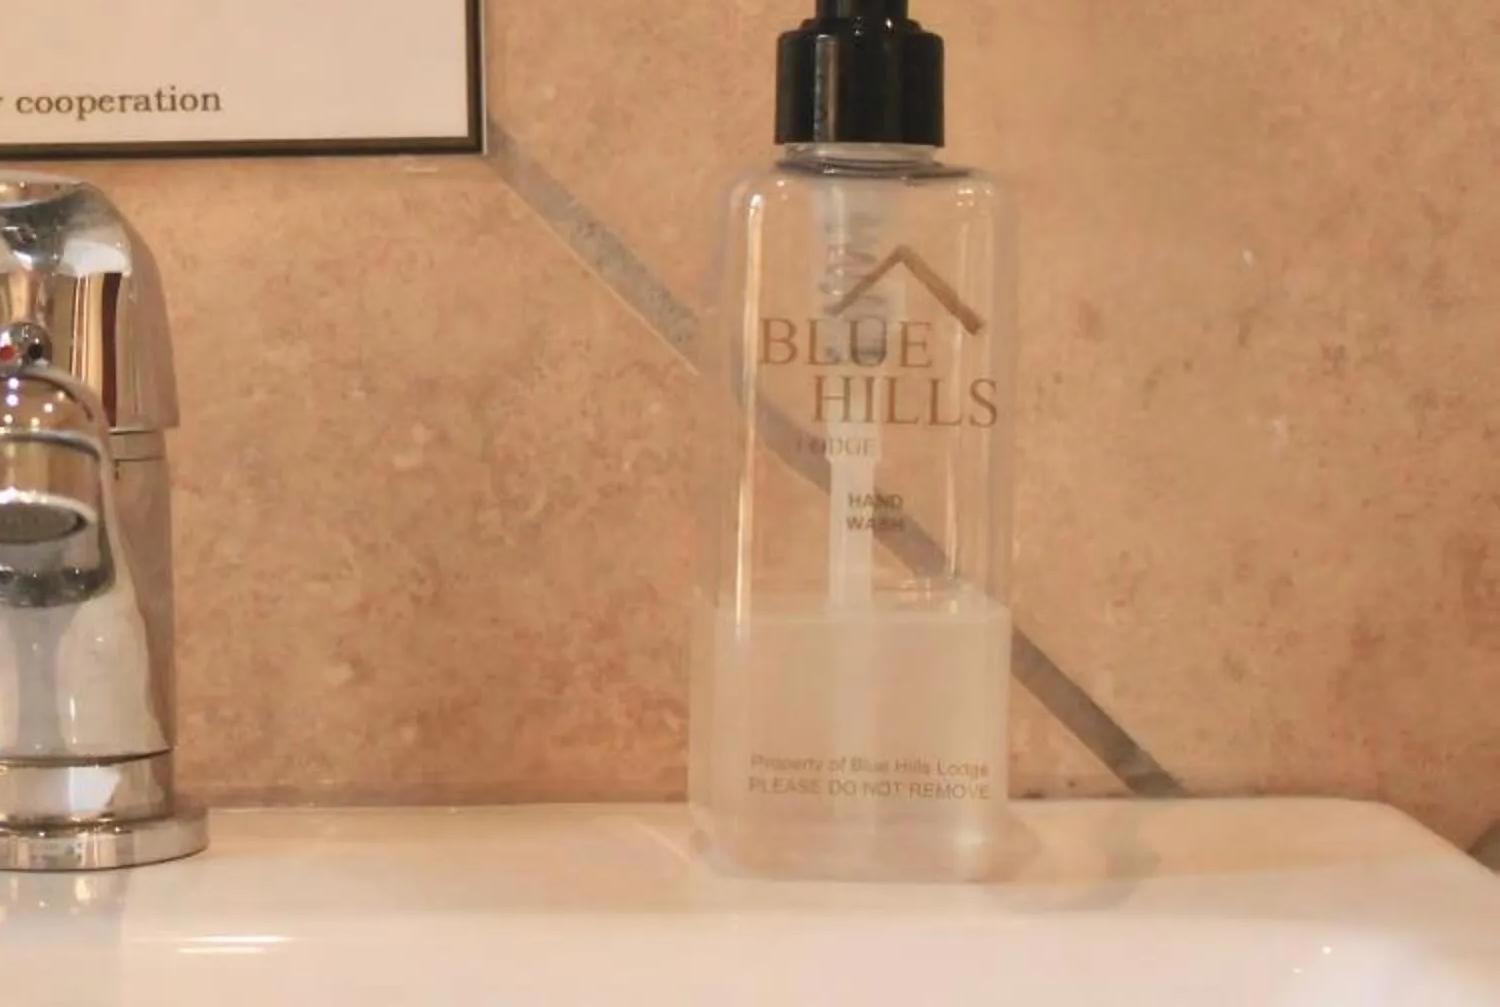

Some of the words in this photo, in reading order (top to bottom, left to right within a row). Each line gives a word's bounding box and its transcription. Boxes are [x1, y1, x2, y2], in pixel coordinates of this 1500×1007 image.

[14, 84, 223, 122] cooperation
[759, 317, 934, 369] BLUE
[811, 373, 999, 428] HILLS
[847, 492, 904, 509] HAND
[845, 515, 904, 530] WASH
[749, 753, 822, 773] Property
[827, 756, 847, 771] of
[851, 756, 889, 772] Blue
[894, 758, 930, 775] Hills
[936, 759, 990, 780] Lodge
[747, 775, 821, 794] PLEASE
[827, 778, 857, 796] DO
[862, 780, 902, 797] NOT
[908, 781, 991, 800] REMOVE
